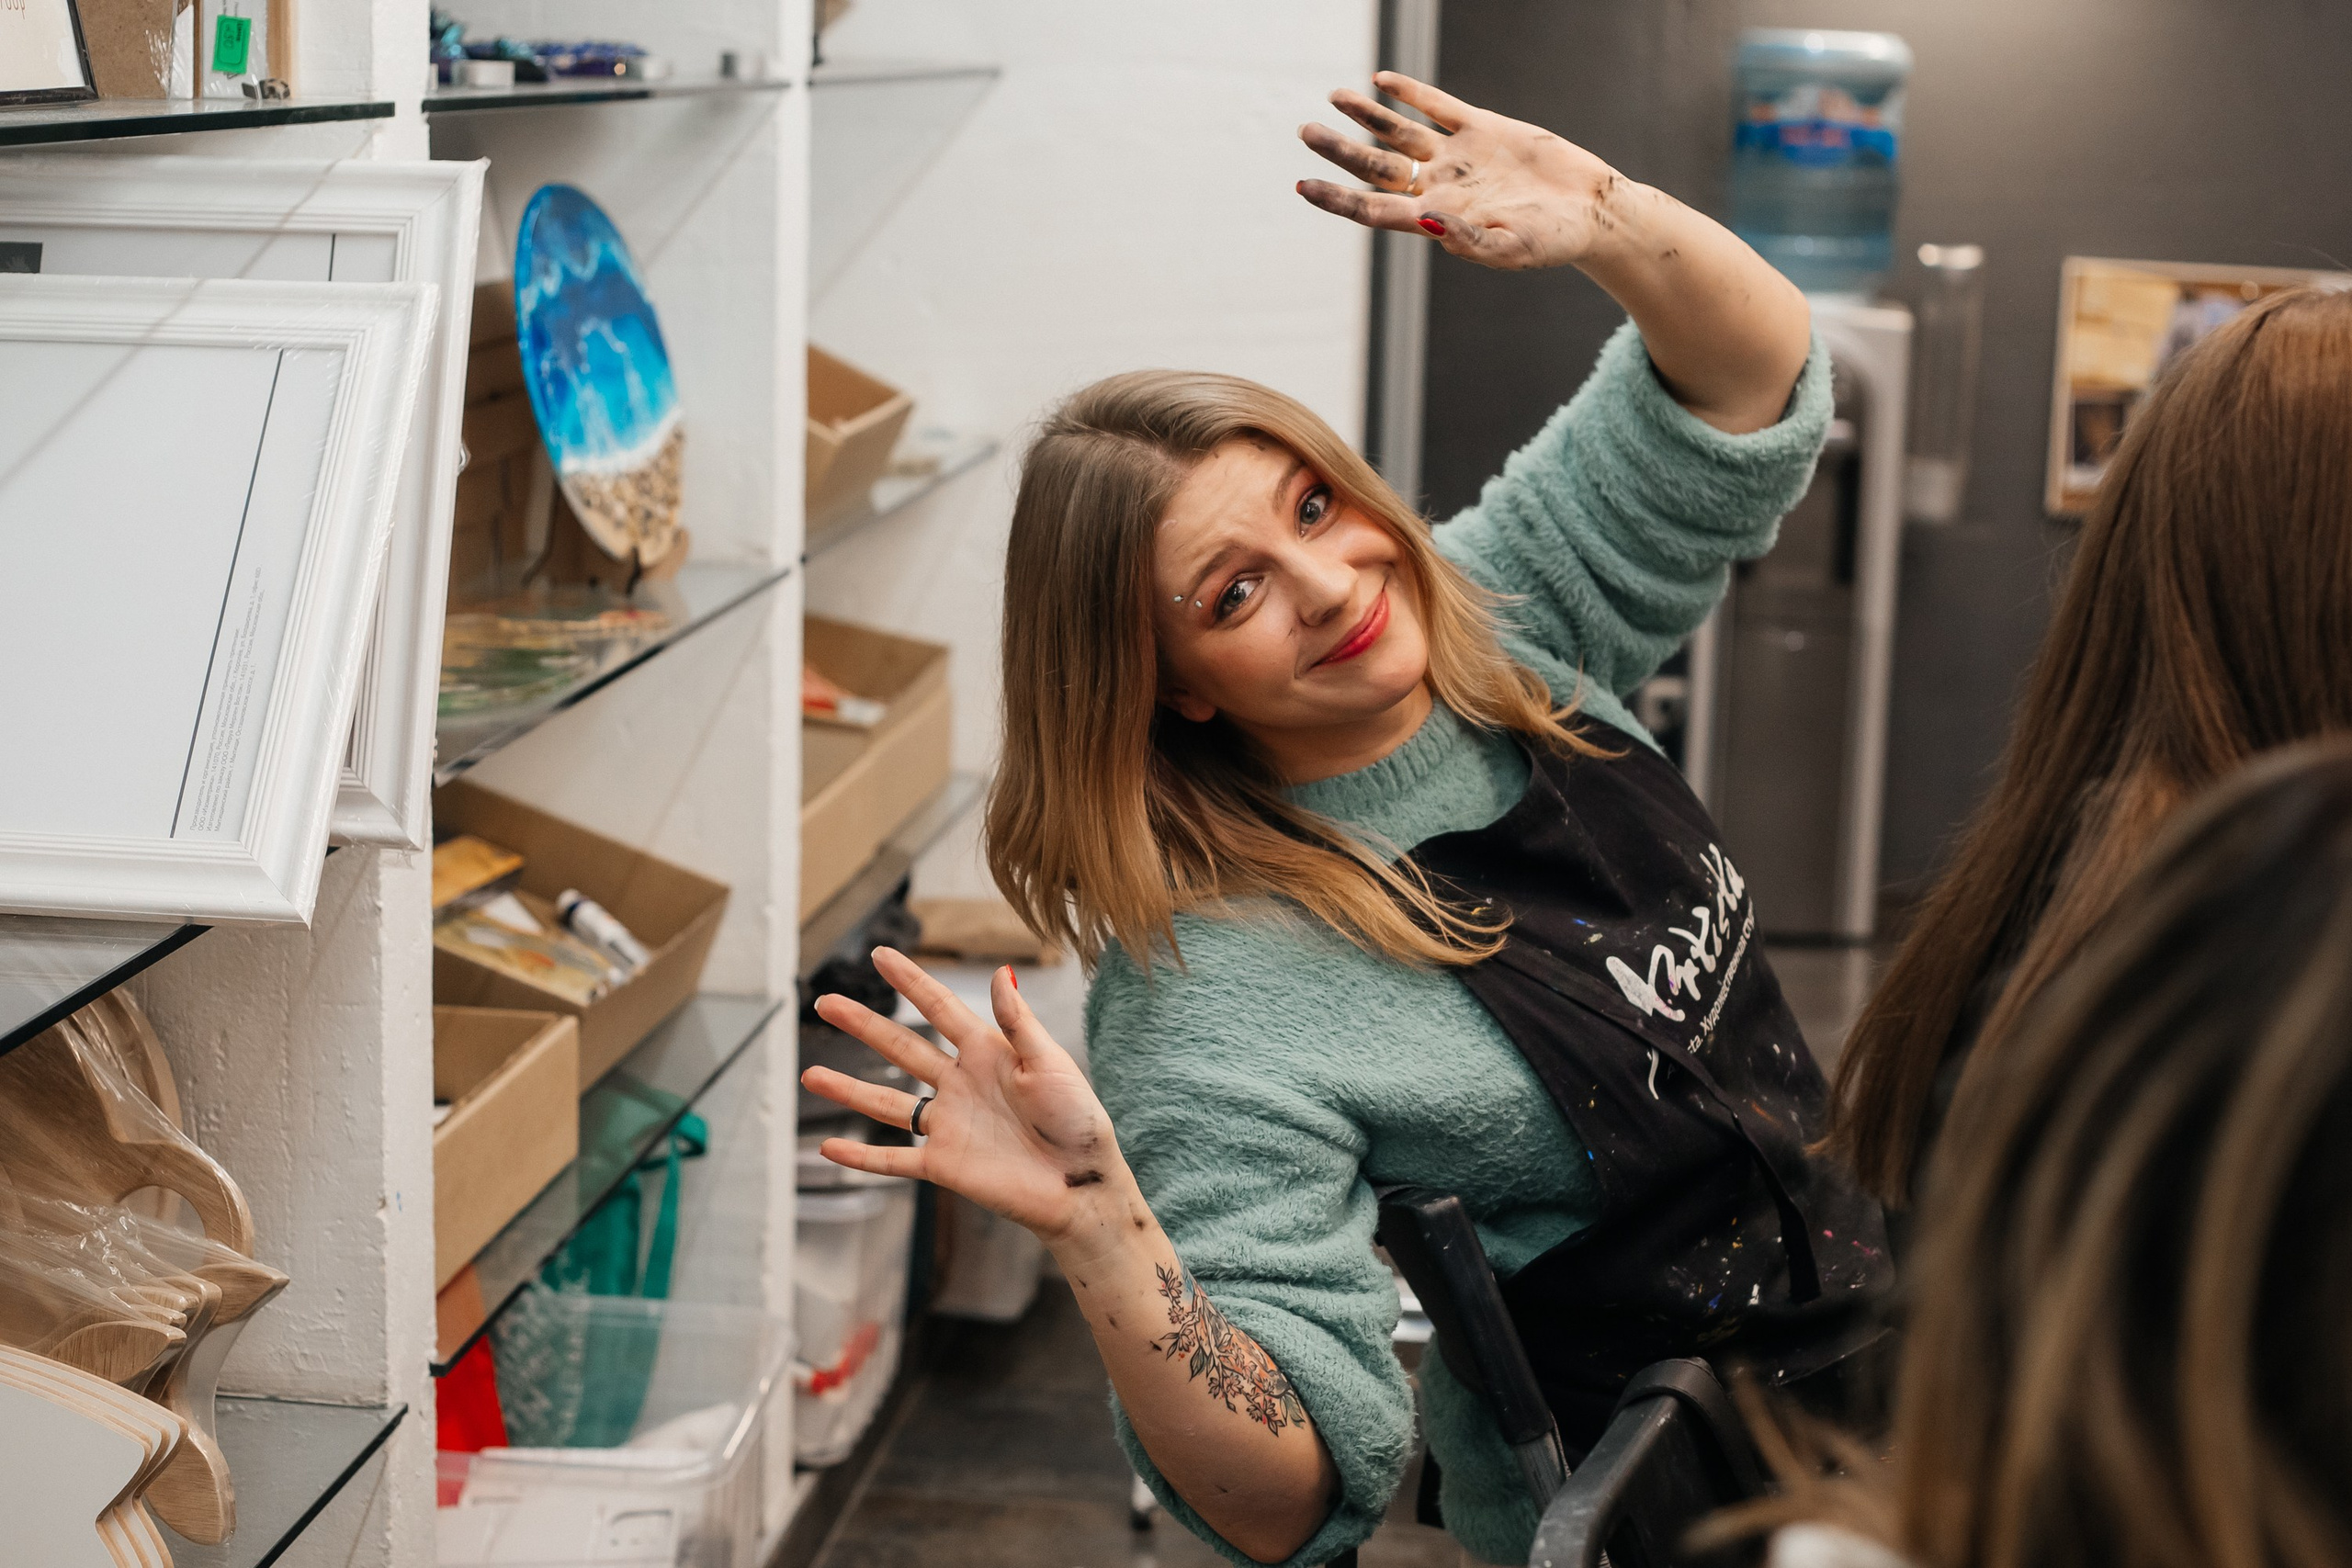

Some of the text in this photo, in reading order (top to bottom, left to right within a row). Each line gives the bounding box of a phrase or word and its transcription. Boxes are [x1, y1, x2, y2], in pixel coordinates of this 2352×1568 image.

[207, 794, 220, 831] Изготовлено
[218, 766, 227, 784] заказу
[214, 789, 229, 831] Мытищинский
[1700, 935, 1747, 1036] Художественная
